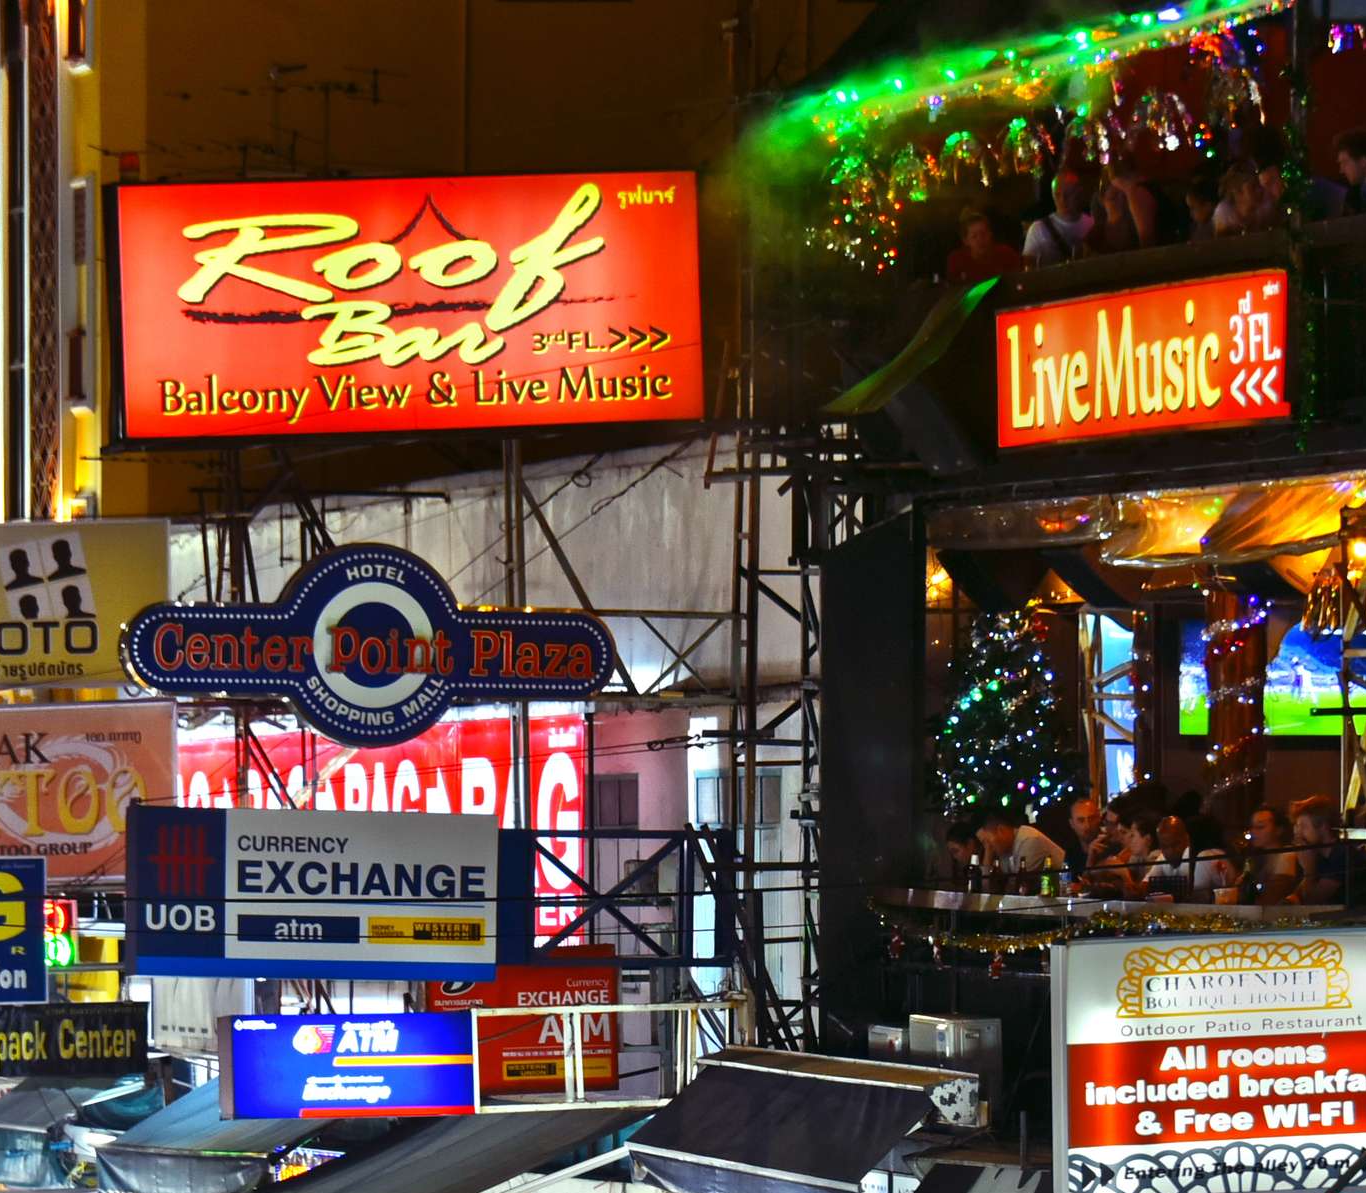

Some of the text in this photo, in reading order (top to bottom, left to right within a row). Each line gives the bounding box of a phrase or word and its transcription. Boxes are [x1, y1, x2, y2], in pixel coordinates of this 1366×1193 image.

[178, 183, 605, 333] Roof
[302, 301, 505, 368] Bar
[1007, 304, 1222, 429] Live Music
[161, 365, 673, 424] Balcony View & Live Music
[345, 563, 407, 585] HOTEL
[153, 623, 594, 679] Center Point Plaza
[305, 674, 448, 727] SHOPPING MALL
[36, 842, 93, 856] GROUP
[237, 834, 349, 855] CURRENCY
[236, 860, 486, 899] EXCHANGE
[145, 904, 216, 933] UOB
[274, 919, 323, 941] atm
[414, 922, 470, 932] WESTERN
[566, 977, 610, 989] Currency
[517, 989, 610, 1007] EXCHANGE
[58, 1018, 137, 1060] Center
[538, 1012, 612, 1045] AM
[1119, 1013, 1364, 1038] Outdoor Patio Restaurant
[336, 1028, 400, 1054] ATM
[1159, 1043, 1327, 1071] All rooms
[302, 1083, 392, 1104] Exchange
[1084, 1075, 1230, 1106] included
[1134, 1100, 1355, 1135] & Free WI-FI
[1123, 1164, 1205, 1181] Entering
[1211, 1161, 1245, 1175] The
[1305, 1157, 1329, 1171] 20
